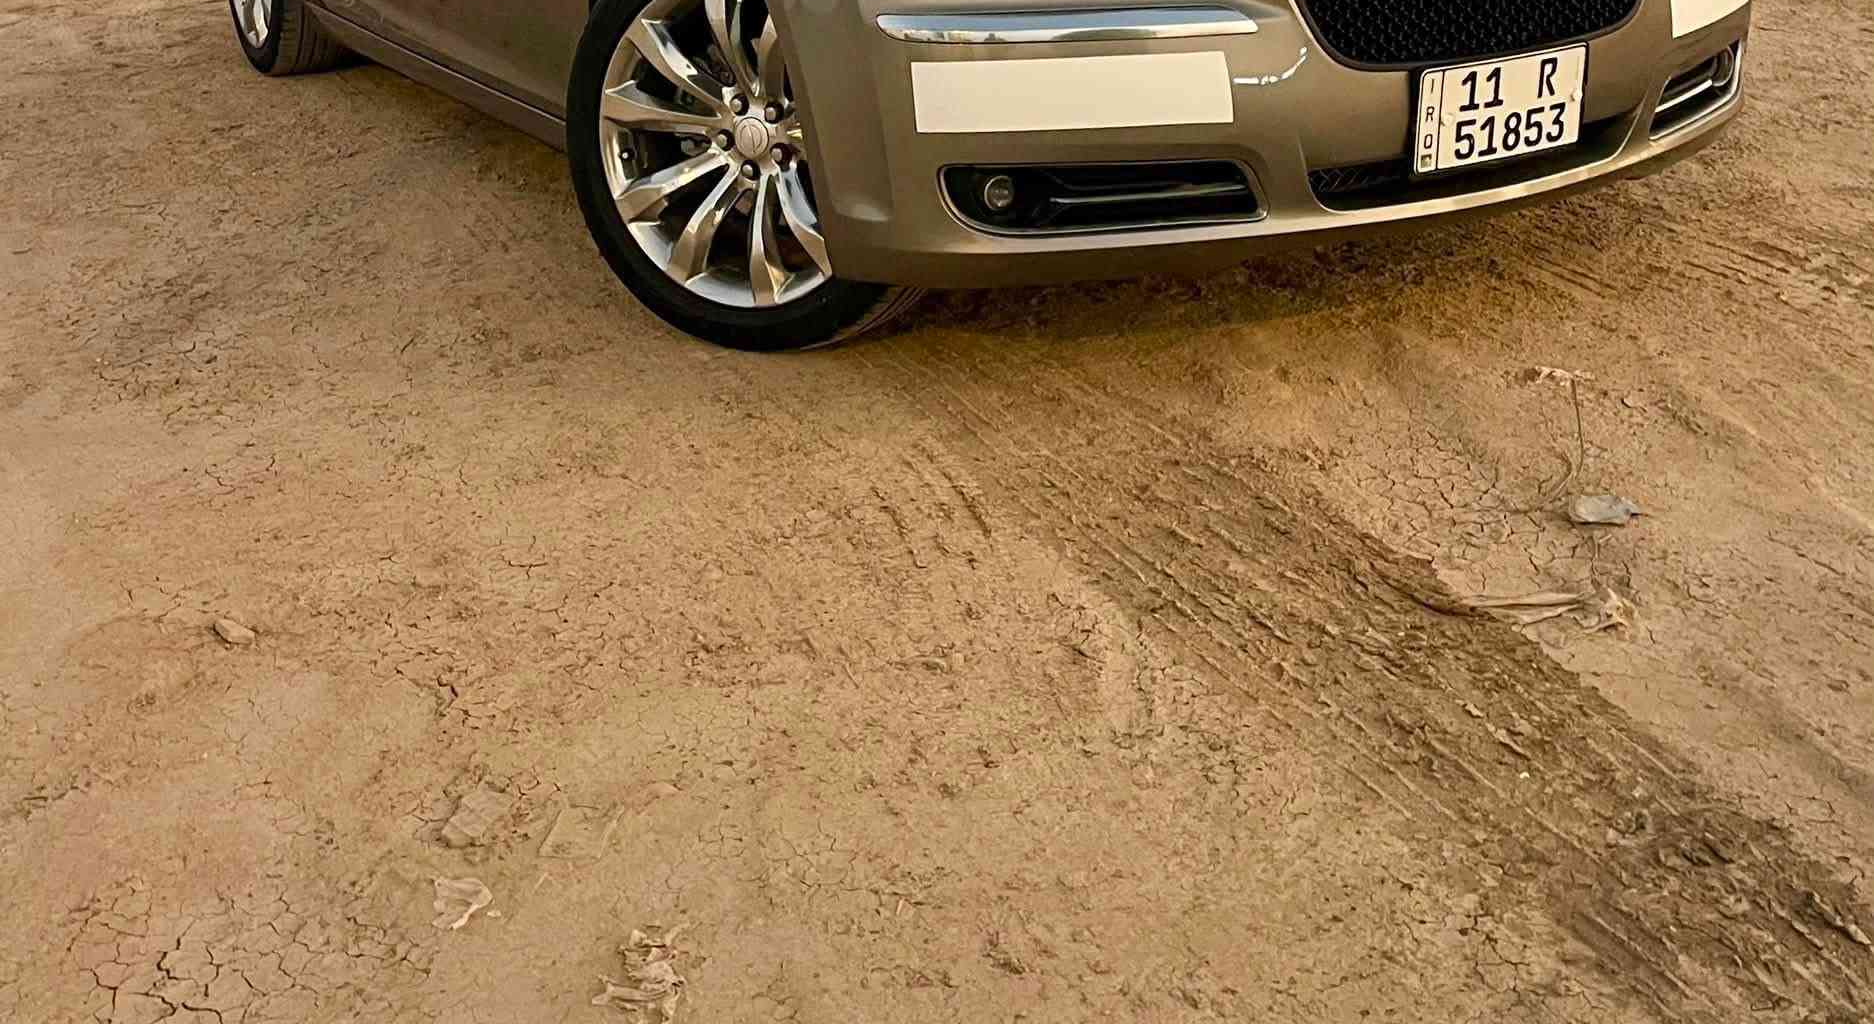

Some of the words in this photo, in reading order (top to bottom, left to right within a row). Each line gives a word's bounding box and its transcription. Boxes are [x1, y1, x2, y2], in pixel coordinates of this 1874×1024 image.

[1459, 66, 1504, 112] 11
[1537, 57, 1558, 98] R
[1454, 102, 1566, 160] 51853
